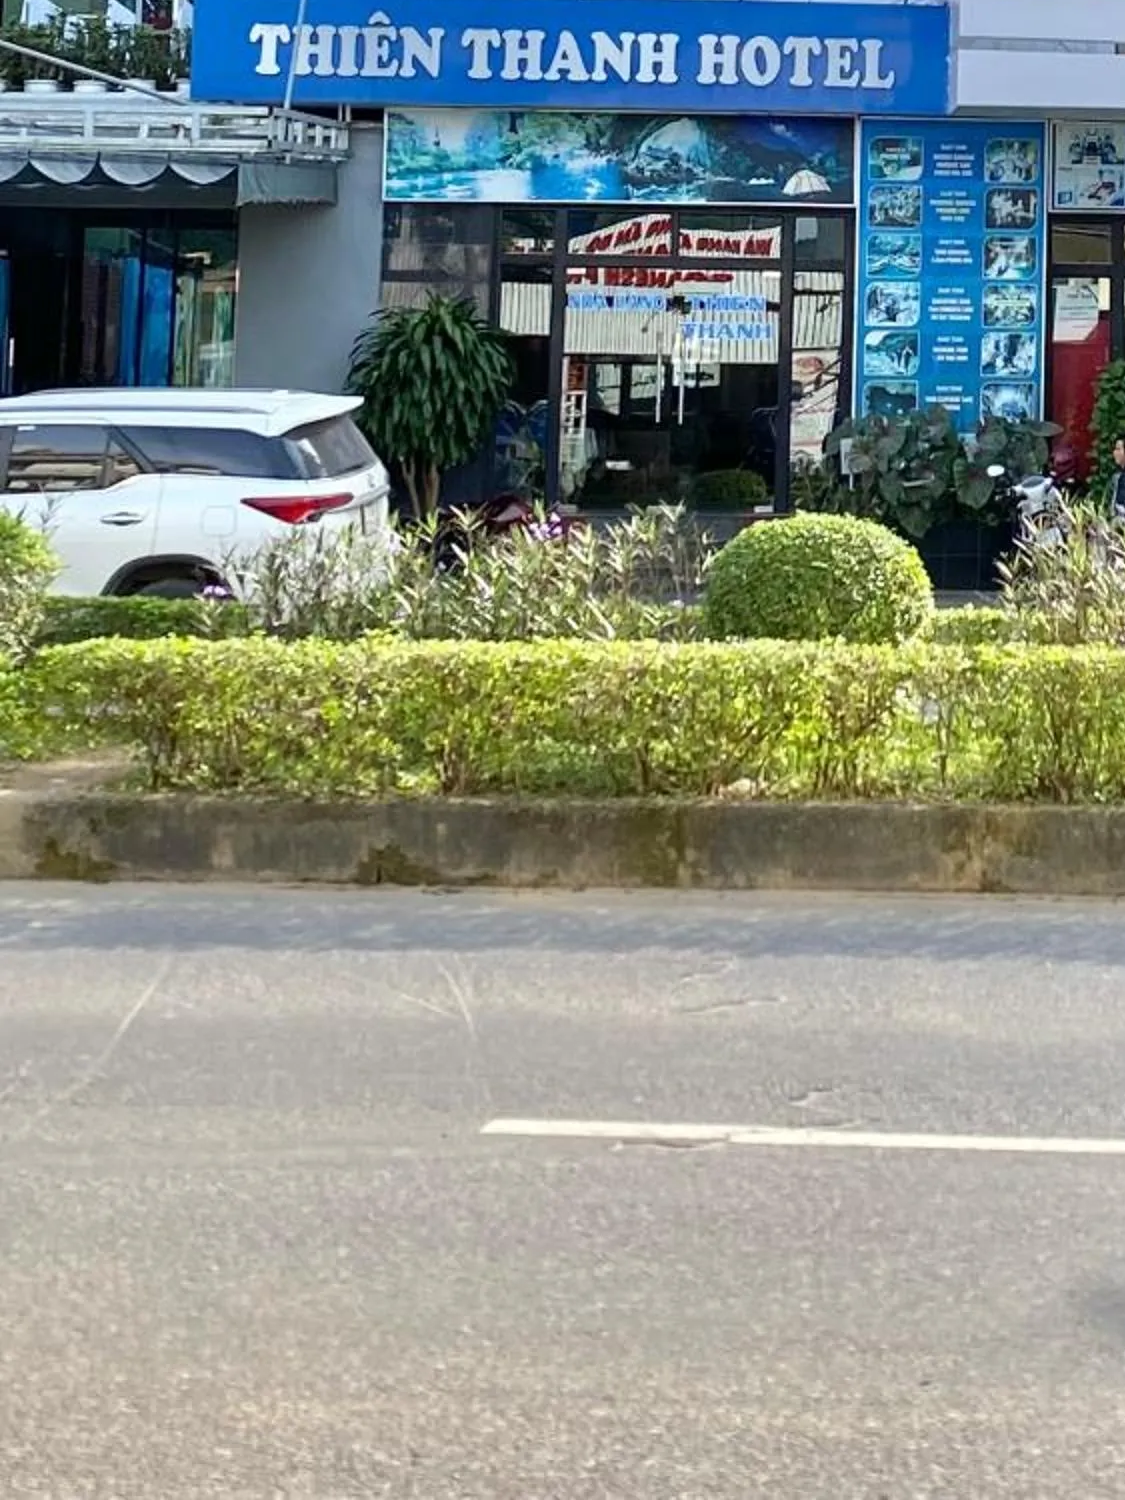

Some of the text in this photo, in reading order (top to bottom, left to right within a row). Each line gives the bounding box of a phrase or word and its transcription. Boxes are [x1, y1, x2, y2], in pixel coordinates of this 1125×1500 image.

[249, 10, 896, 89] THIÊN THANH HOTEL
